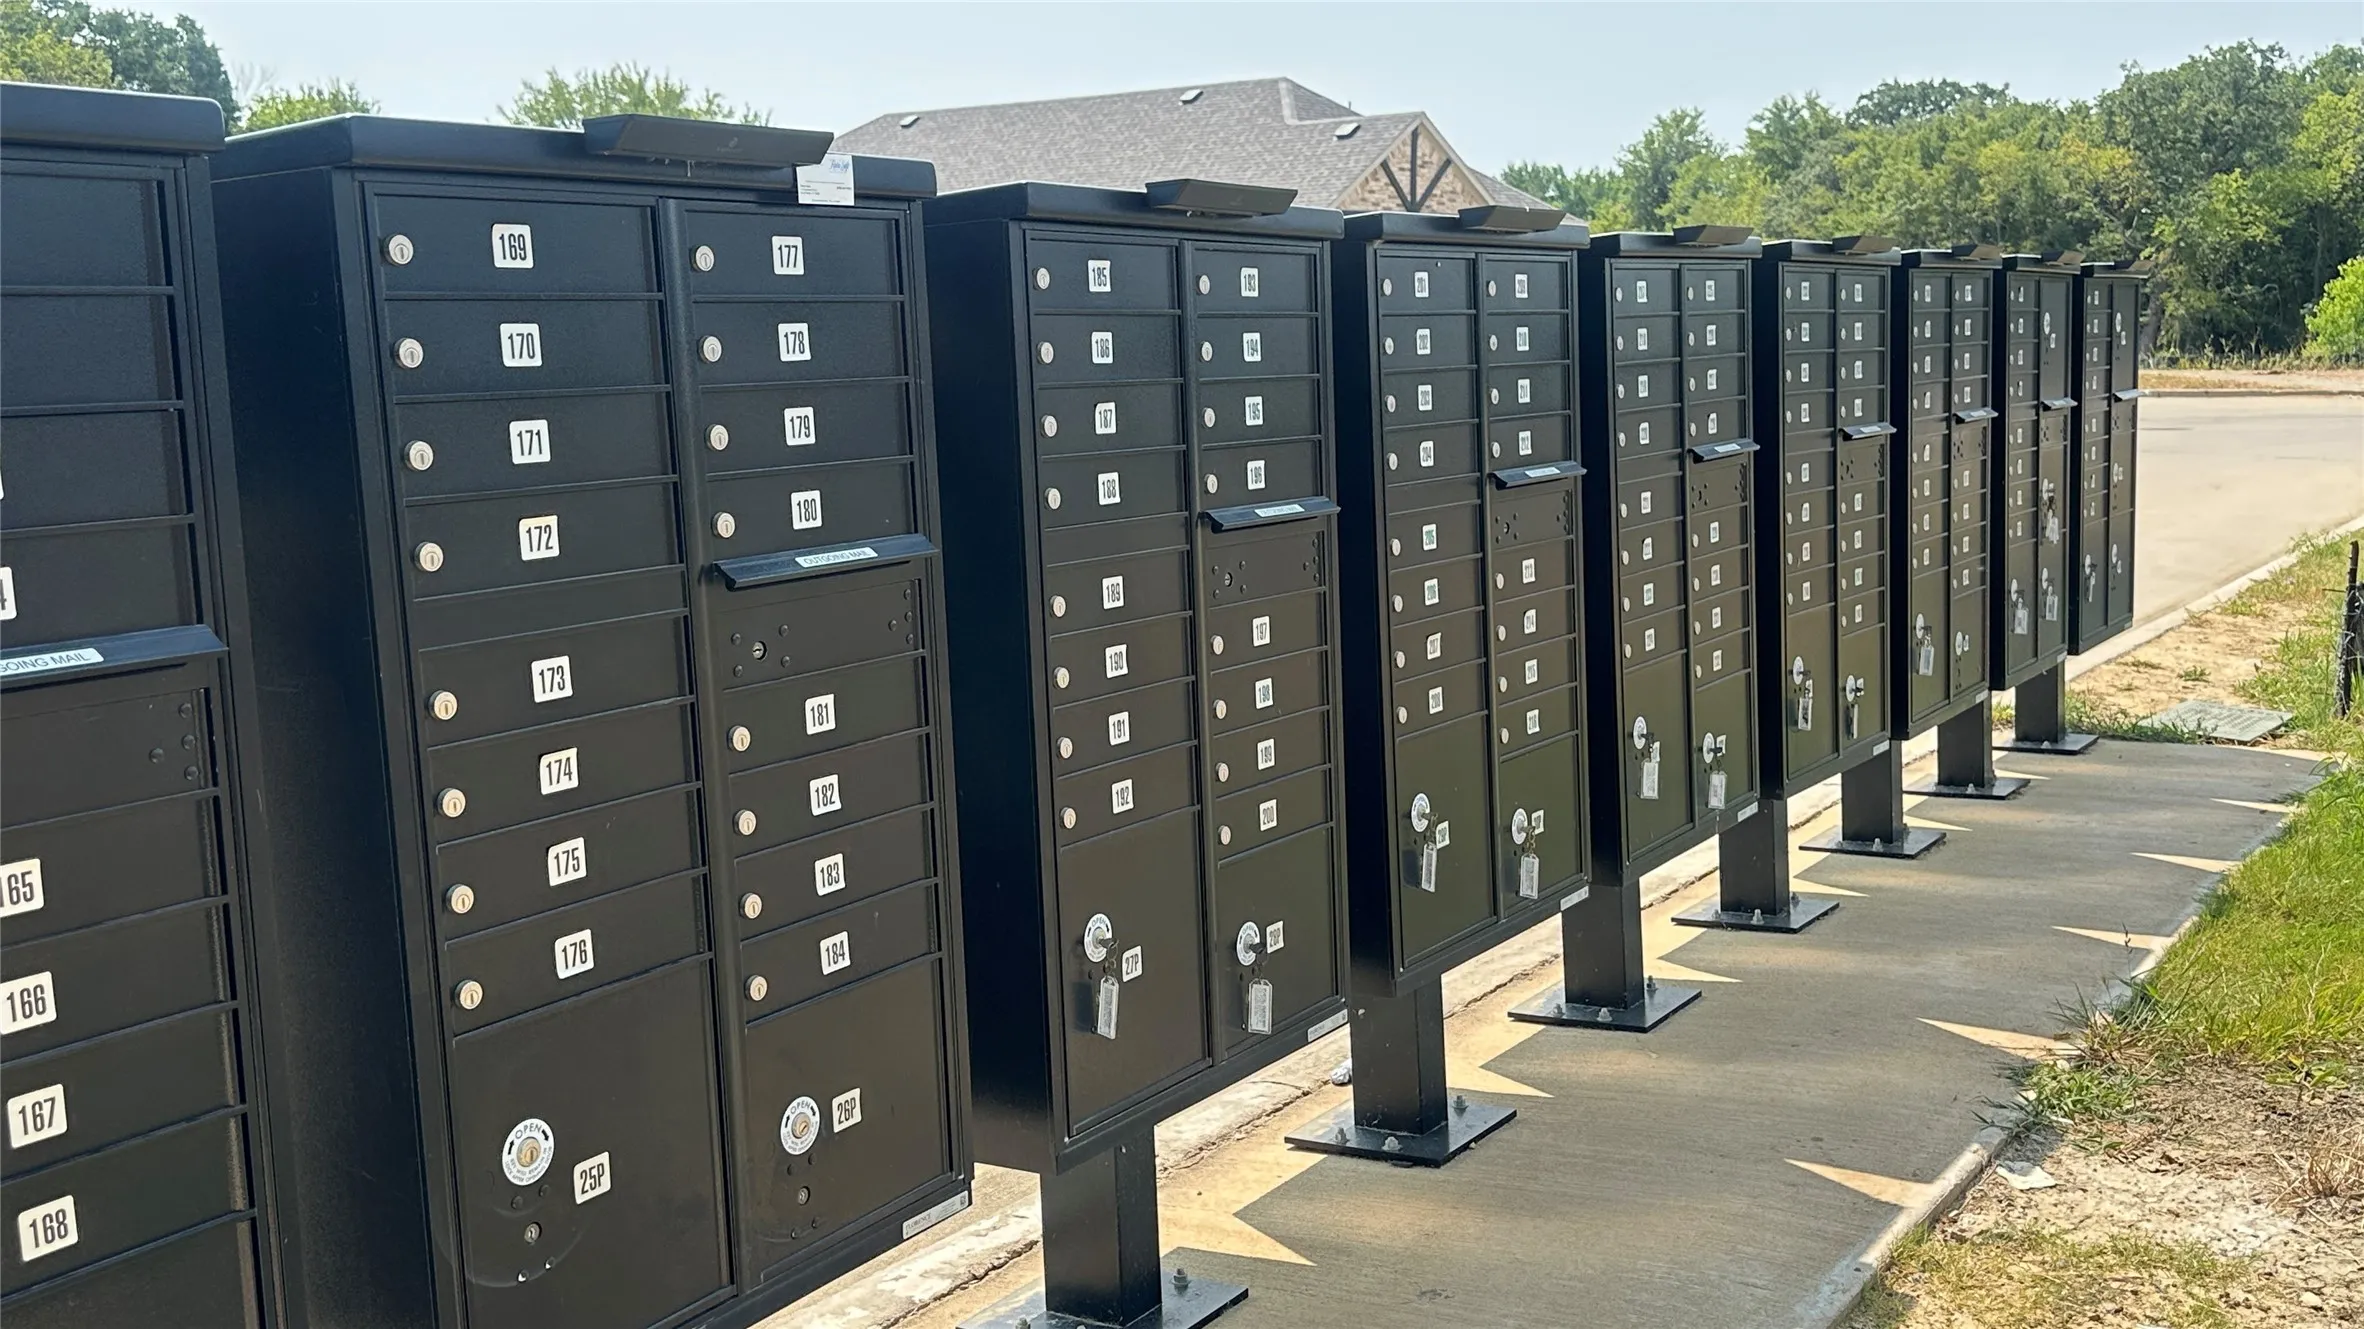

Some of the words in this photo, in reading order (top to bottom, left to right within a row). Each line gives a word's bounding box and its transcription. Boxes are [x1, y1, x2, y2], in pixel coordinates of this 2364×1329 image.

[499, 234, 527, 260] 169
[778, 245, 798, 268] 177
[1092, 267, 1107, 286] 185
[508, 333, 535, 359] 170
[784, 331, 805, 354] 178
[1095, 338, 1110, 358] 186
[790, 415, 810, 438] 179
[1099, 409, 1112, 428] 187
[517, 430, 542, 456] 171
[1102, 479, 1116, 499] 188
[797, 498, 817, 522] 180
[526, 524, 553, 552] 172
[803, 552, 850, 564] OUTGOING
[849, 550, 871, 559] MAIL
[1106, 583, 1120, 602] 189
[1256, 622, 1267, 640] 197
[0, 658, 48, 672] GOING
[50, 653, 91, 664] MAIL
[1109, 651, 1123, 672] 190
[539, 666, 565, 694] 173
[810, 703, 829, 727] 181
[1112, 719, 1125, 739] 191
[546, 757, 572, 786] 174
[815, 783, 835, 808] 182
[1116, 786, 1129, 807] 192
[554, 847, 580, 876] 175
[820, 862, 840, 888] 183
[1091, 916, 1107, 927] OPEN
[562, 940, 587, 969] 176
[826, 940, 845, 966] 184
[1125, 954, 1139, 976] 27P
[7, 984, 46, 1022] 166
[19, 1097, 55, 1135] 167
[790, 1100, 811, 1114] OPEN
[838, 1097, 856, 1125] 26P
[515, 1123, 542, 1139] OPEN
[580, 1163, 604, 1194] 25P
[29, 1209, 68, 1248] 168
